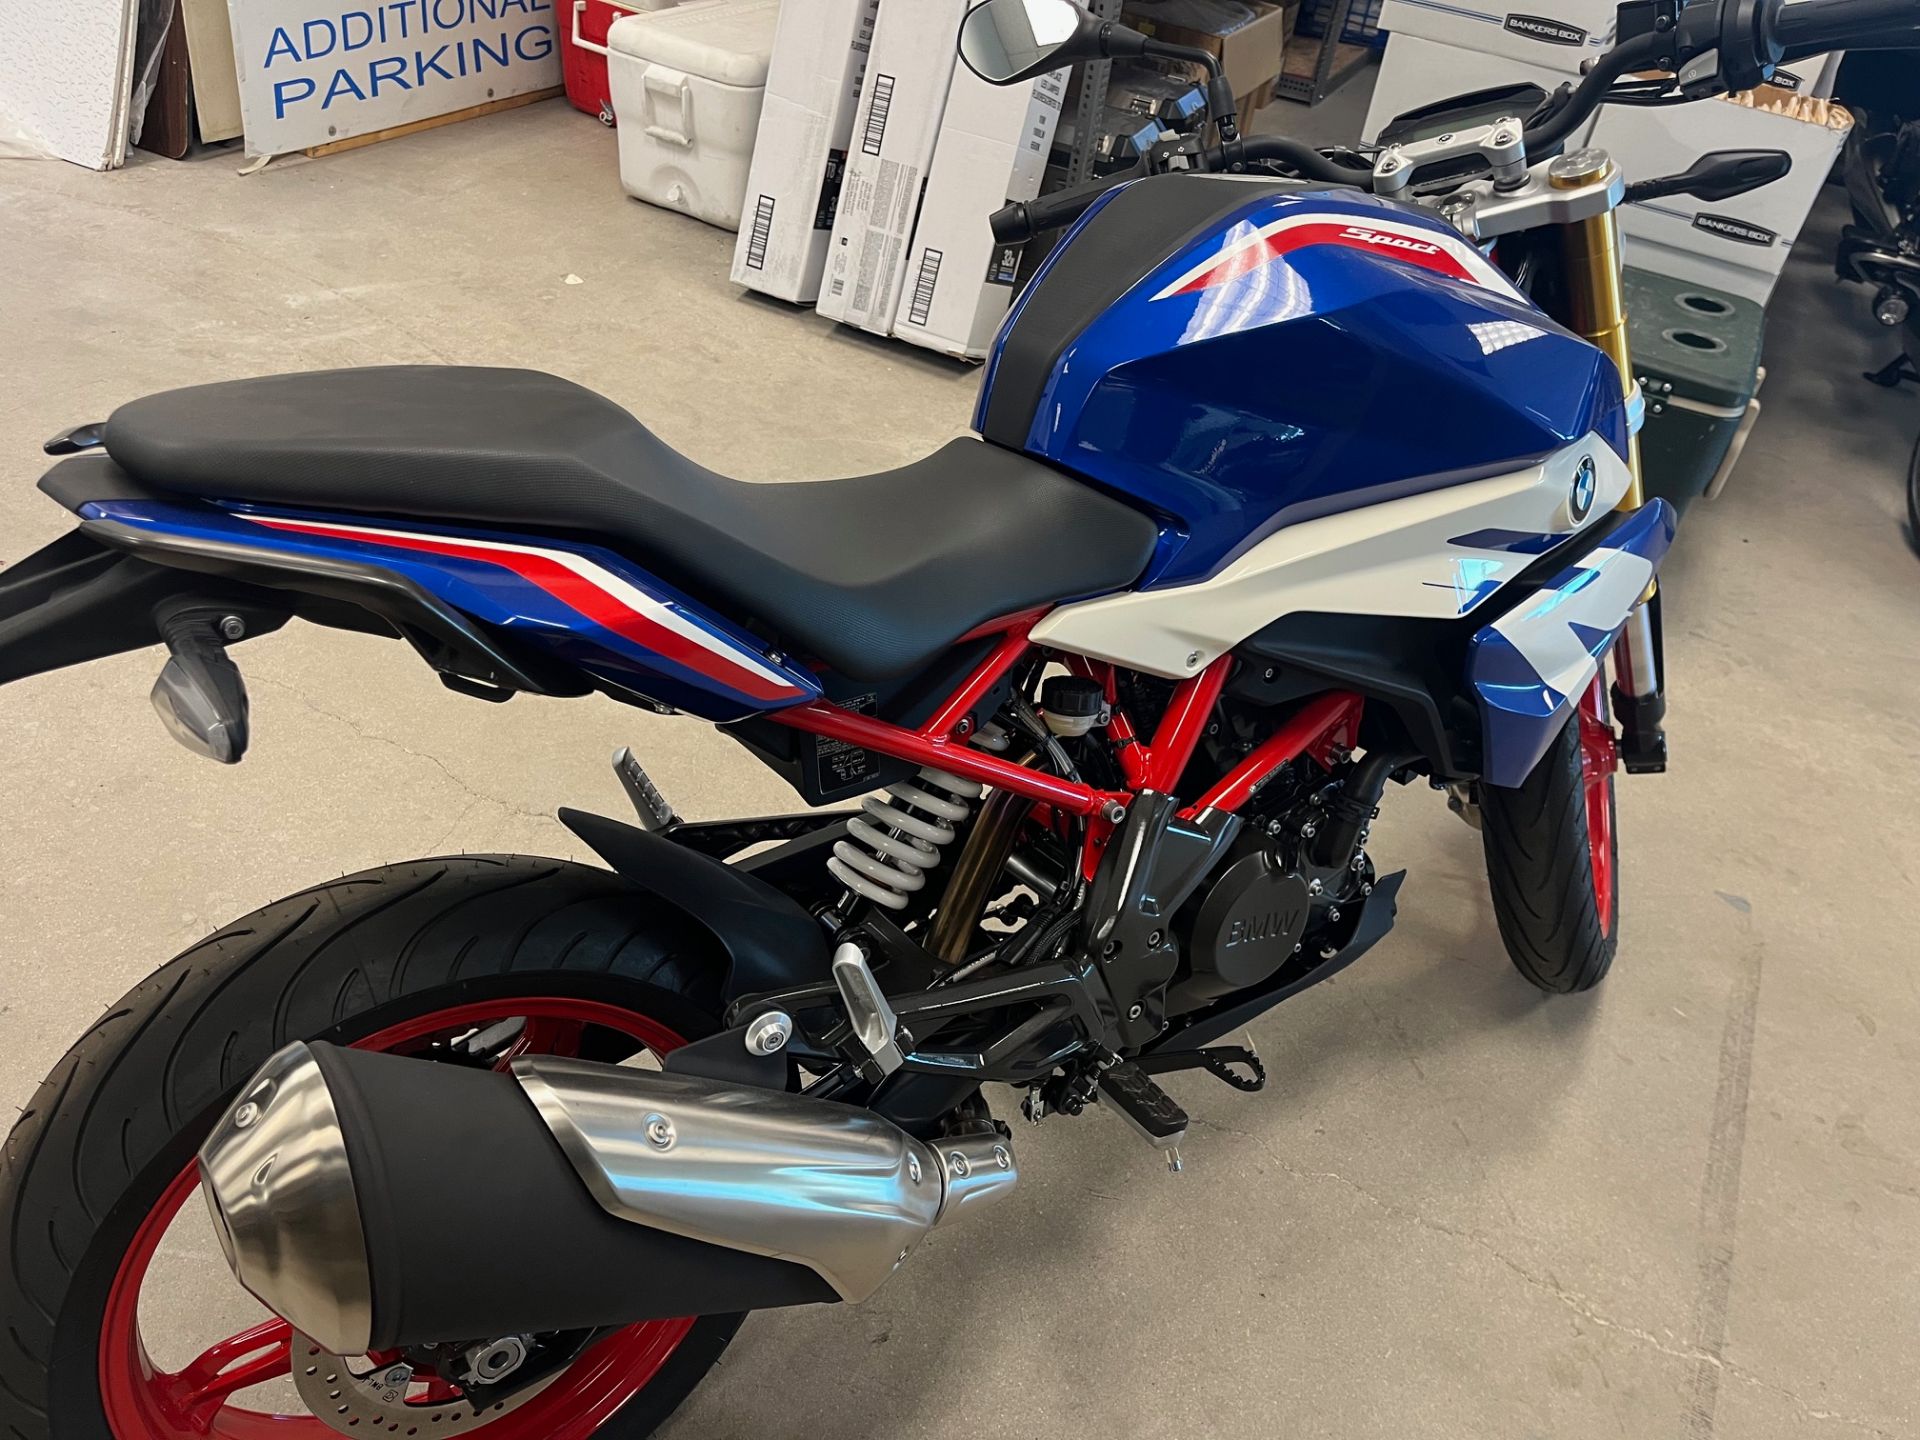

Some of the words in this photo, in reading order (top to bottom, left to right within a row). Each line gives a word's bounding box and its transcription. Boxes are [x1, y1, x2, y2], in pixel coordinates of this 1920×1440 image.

[1509, 18, 1558, 36] BANKERS
[1558, 30, 1581, 42] BOX
[273, 25, 553, 120] PARKING
[1773, 76, 1796, 88] BOX
[1338, 227, 1441, 255] Sport
[1697, 217, 1747, 236] BANKERS
[1747, 231, 1771, 243] BOX
[1226, 910, 1300, 948] BMW
